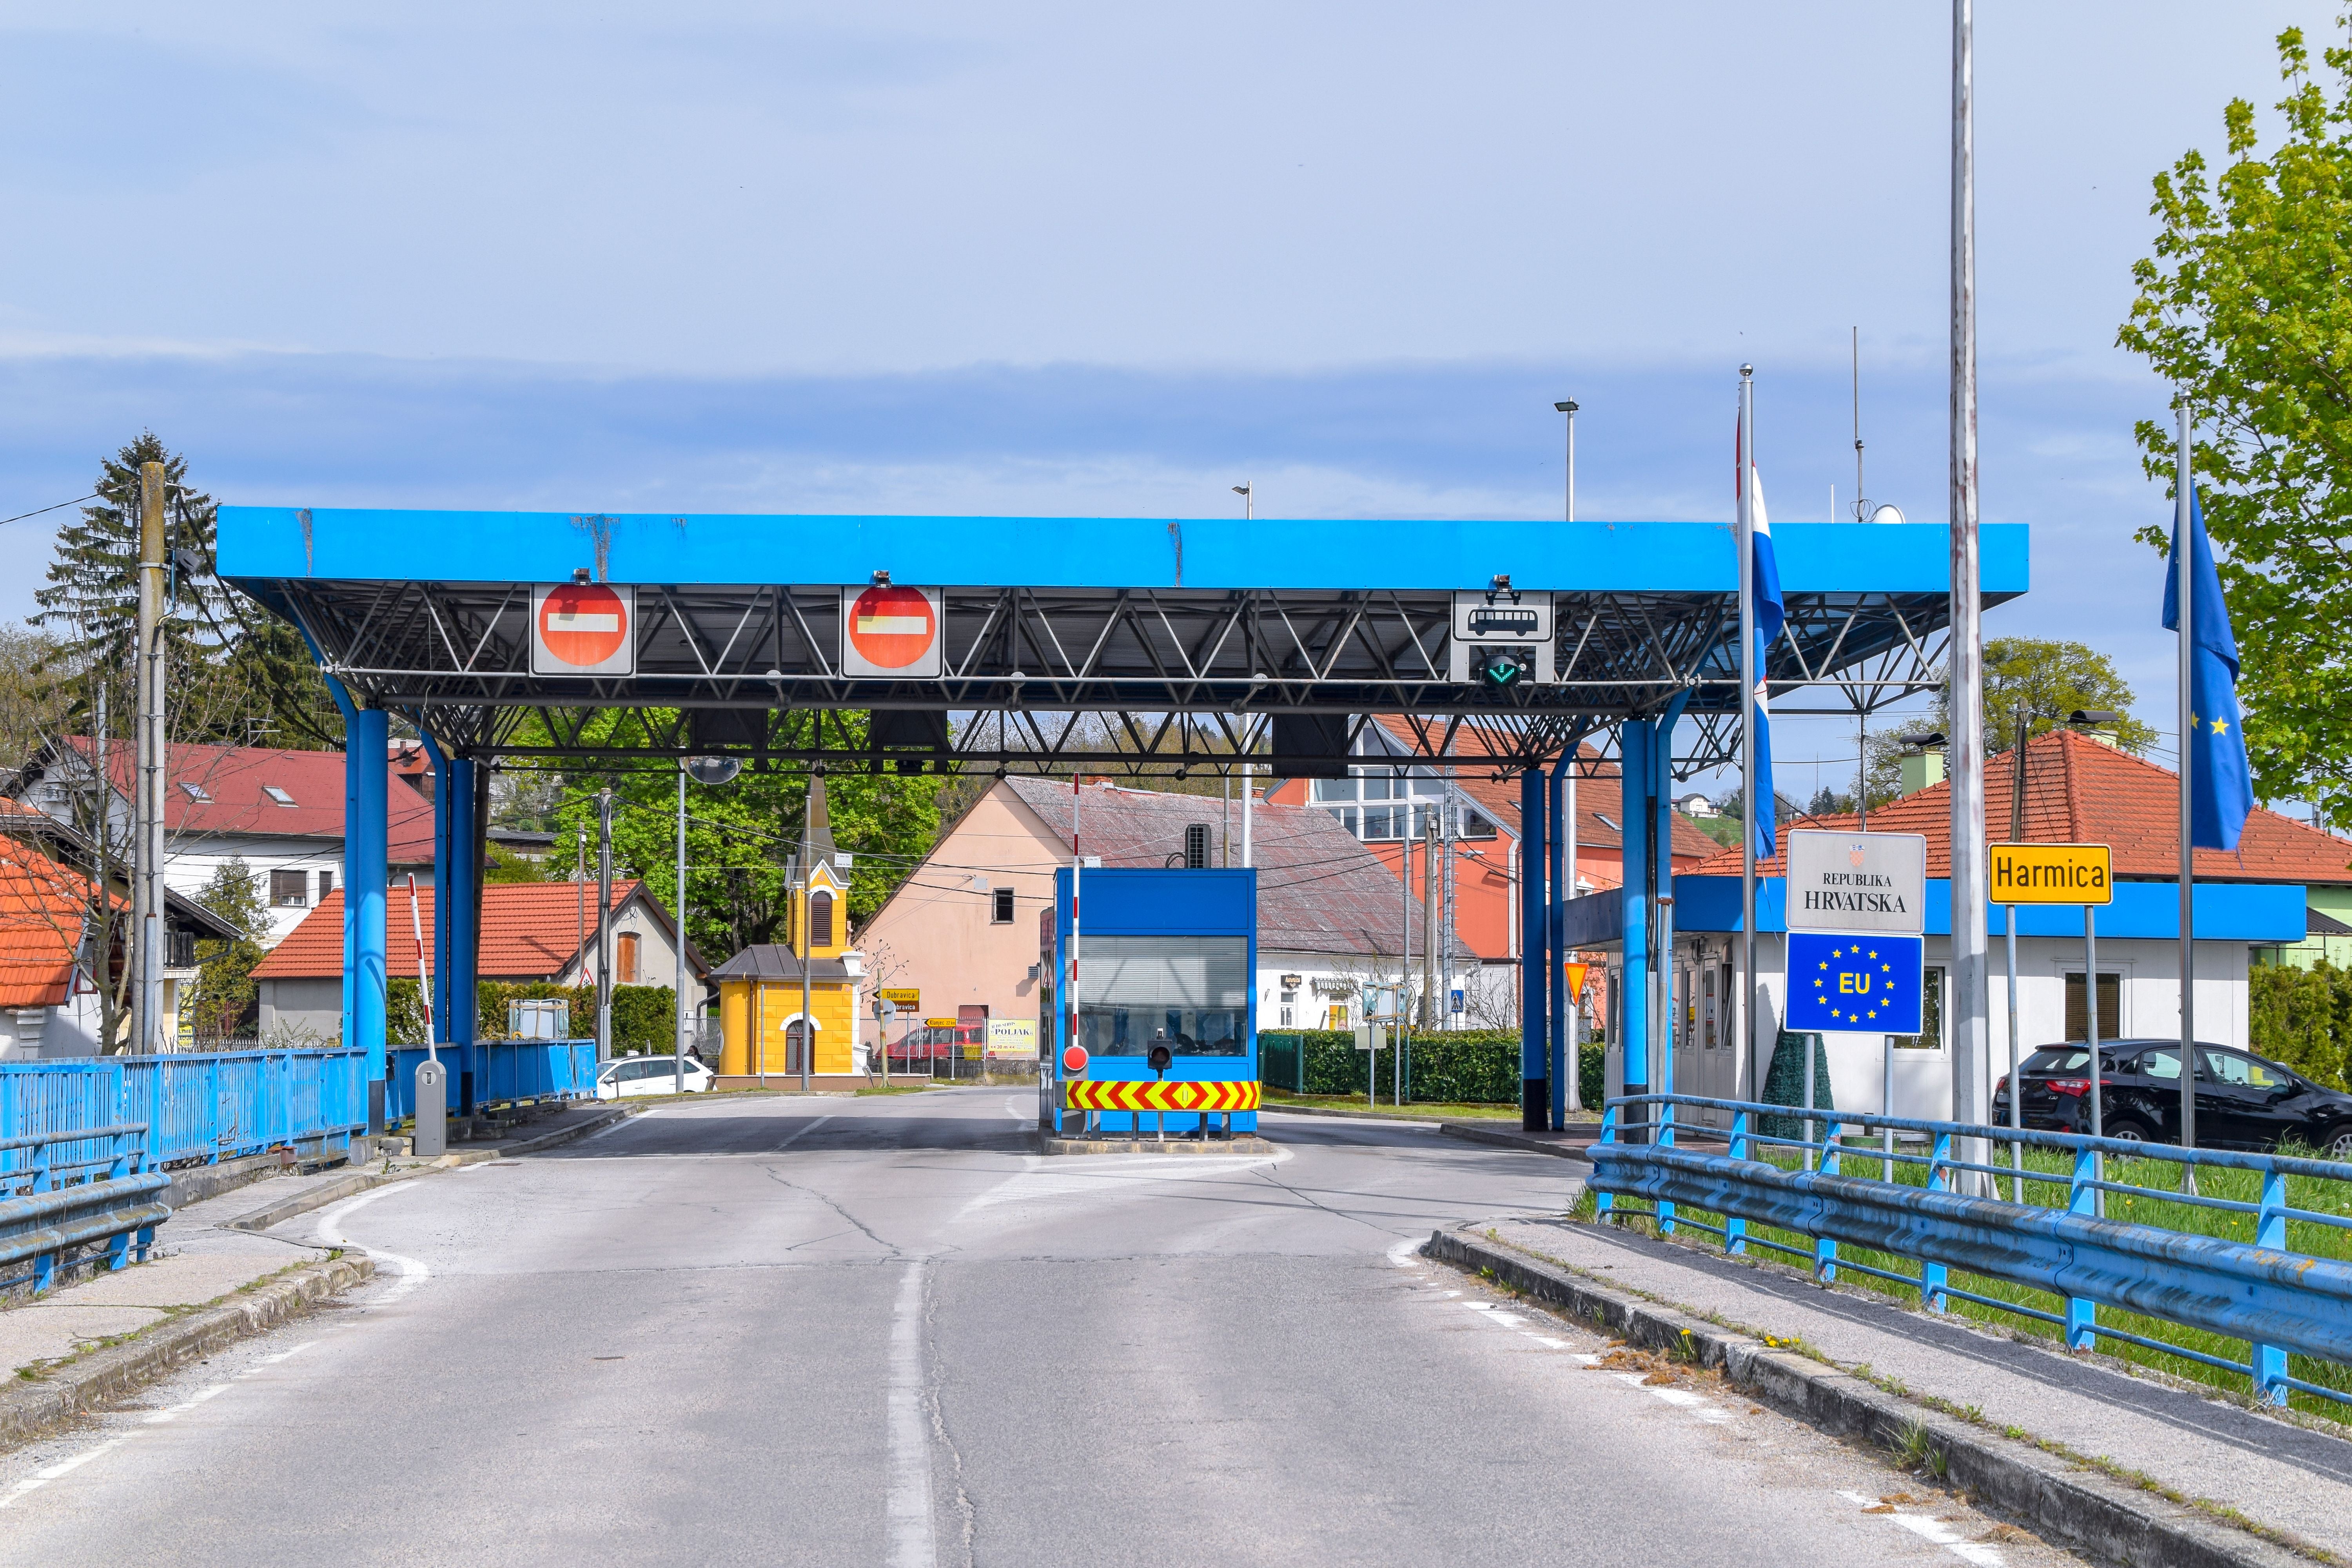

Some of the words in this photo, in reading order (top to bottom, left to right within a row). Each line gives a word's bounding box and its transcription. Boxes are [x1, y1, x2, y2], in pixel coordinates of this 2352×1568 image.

[1822, 873, 1892, 887] REPUBLIKA
[1997, 857, 2104, 887] Harmica
[1804, 891, 1907, 913] HRVATSKA
[1840, 973, 1870, 994] EU
